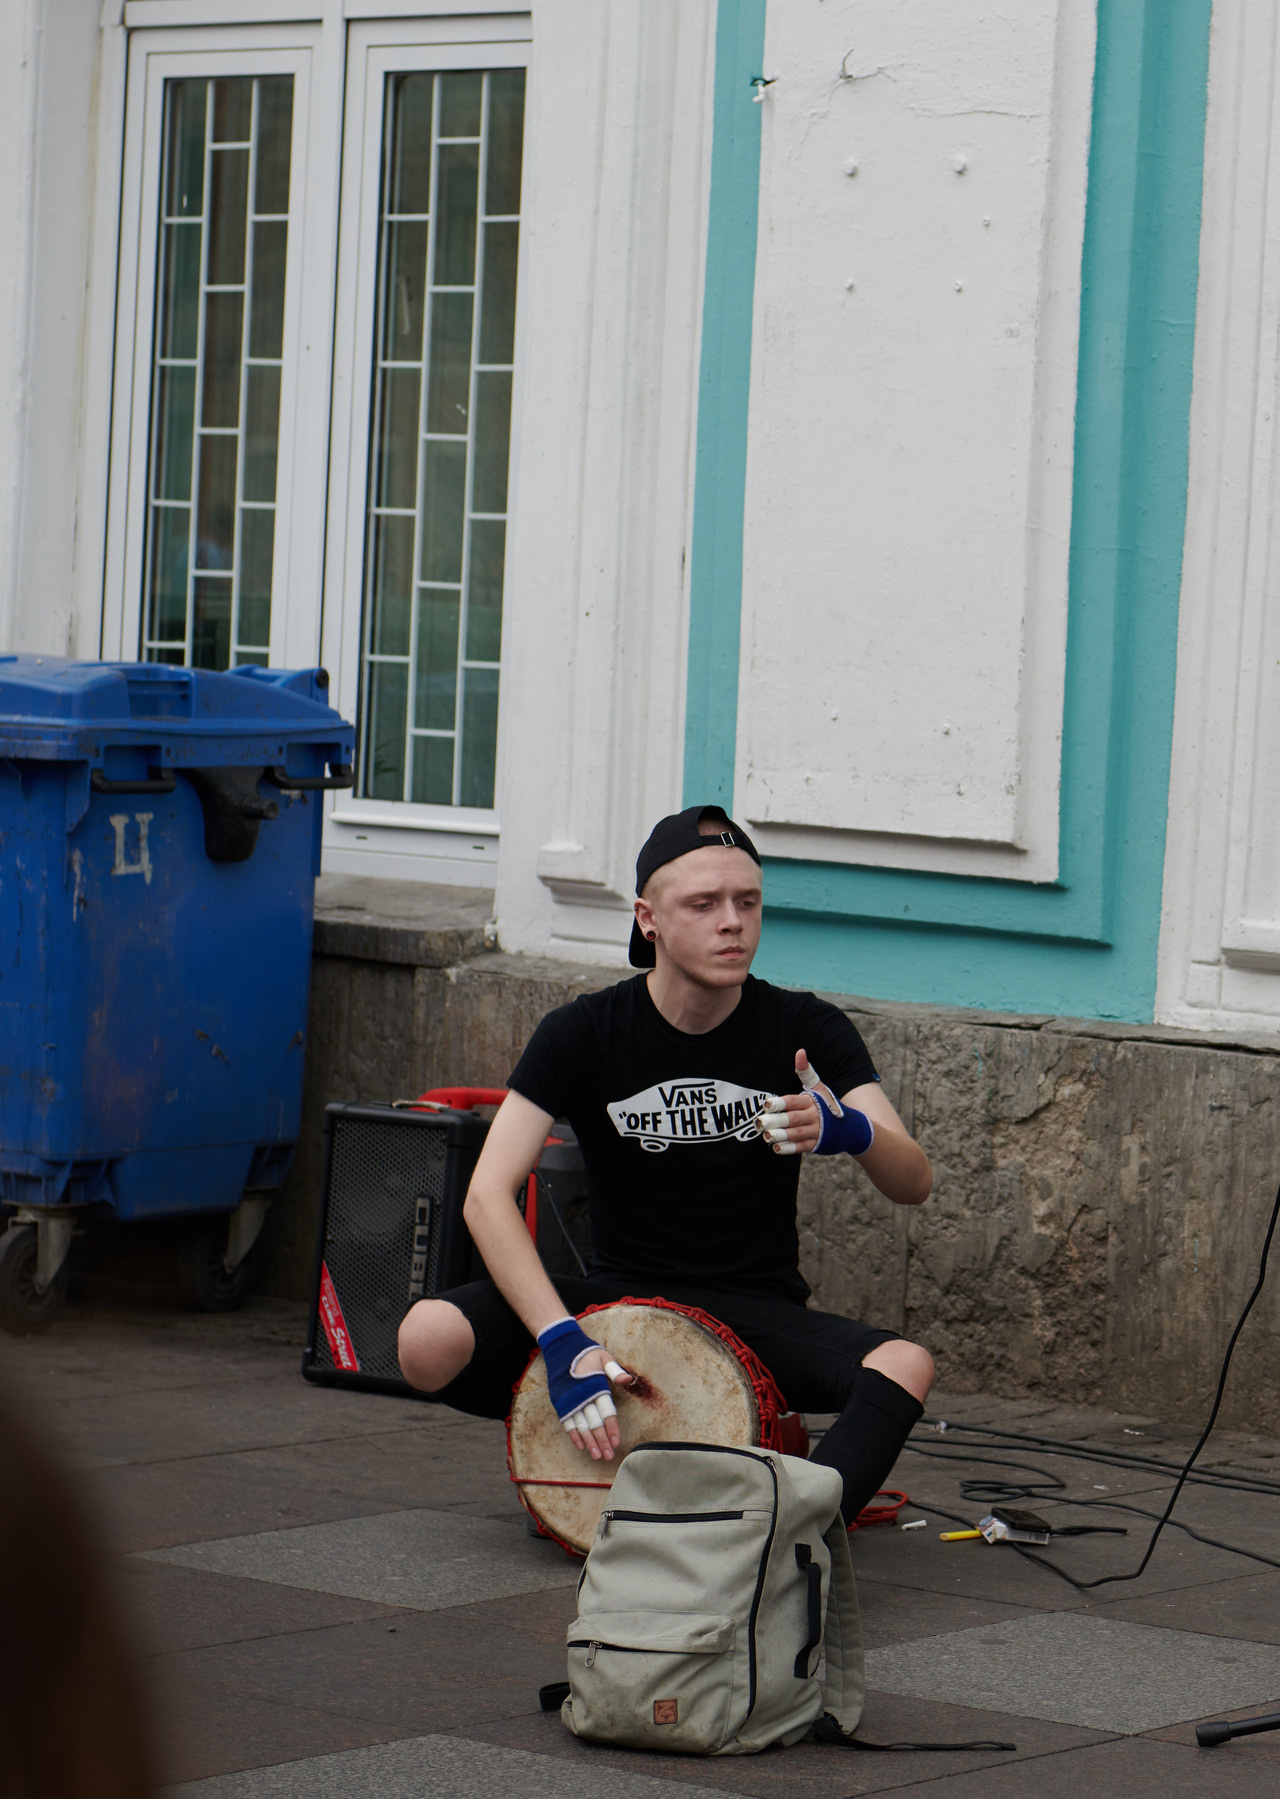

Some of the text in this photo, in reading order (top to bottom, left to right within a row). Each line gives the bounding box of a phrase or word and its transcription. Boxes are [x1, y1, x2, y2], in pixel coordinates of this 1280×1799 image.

[618, 1093, 767, 1136] "OFF THE WALL"
[658, 1081, 717, 1108] VANS
[331, 1327, 352, 1369] Street
